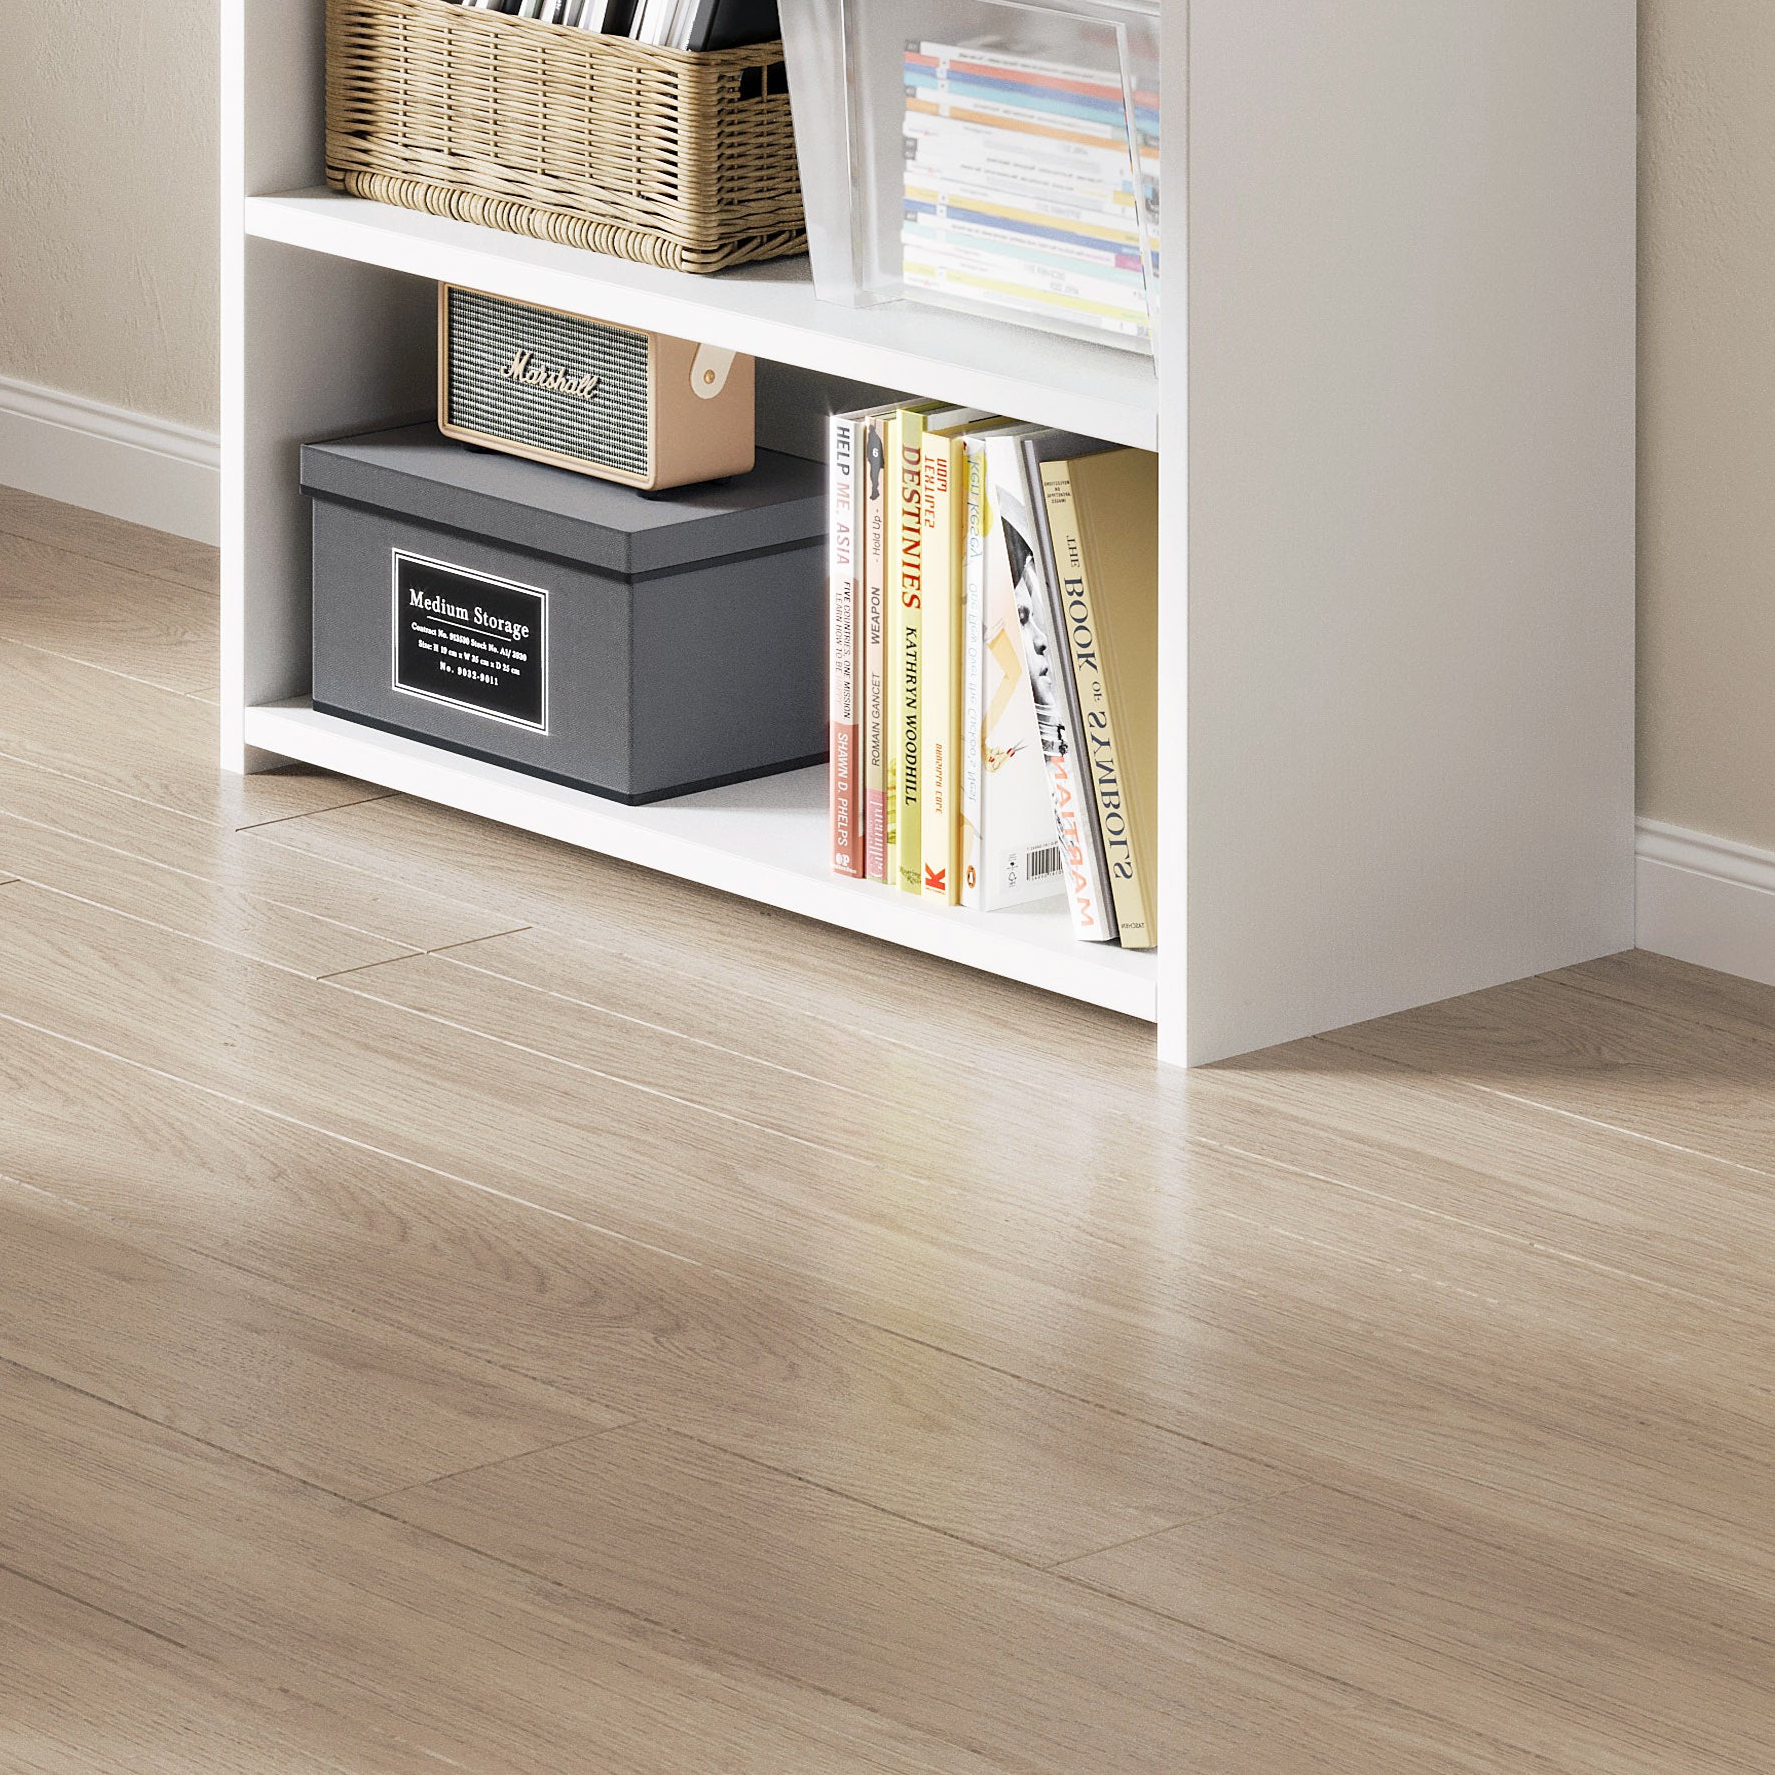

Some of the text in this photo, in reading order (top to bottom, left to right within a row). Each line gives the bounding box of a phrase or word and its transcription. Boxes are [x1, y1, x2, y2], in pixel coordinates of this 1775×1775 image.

[499, 348, 600, 399] Marshall
[836, 425, 851, 566] HELP ASIA
[409, 588, 530, 641] Medium Storage
[843, 581, 851, 602] FIVE
[870, 586, 881, 645] WEAPON
[901, 444, 922, 807] DESTINIES KATHRYN WOODHILL
[439, 661, 455, 674] No.
[843, 660, 851, 680] ONE
[872, 673, 881, 719] GANCET
[836, 732, 849, 779] SHAWN
[871, 723, 880, 767] ROMAIN
[837, 782, 848, 793] D.
[837, 797, 849, 847] PHELPS
